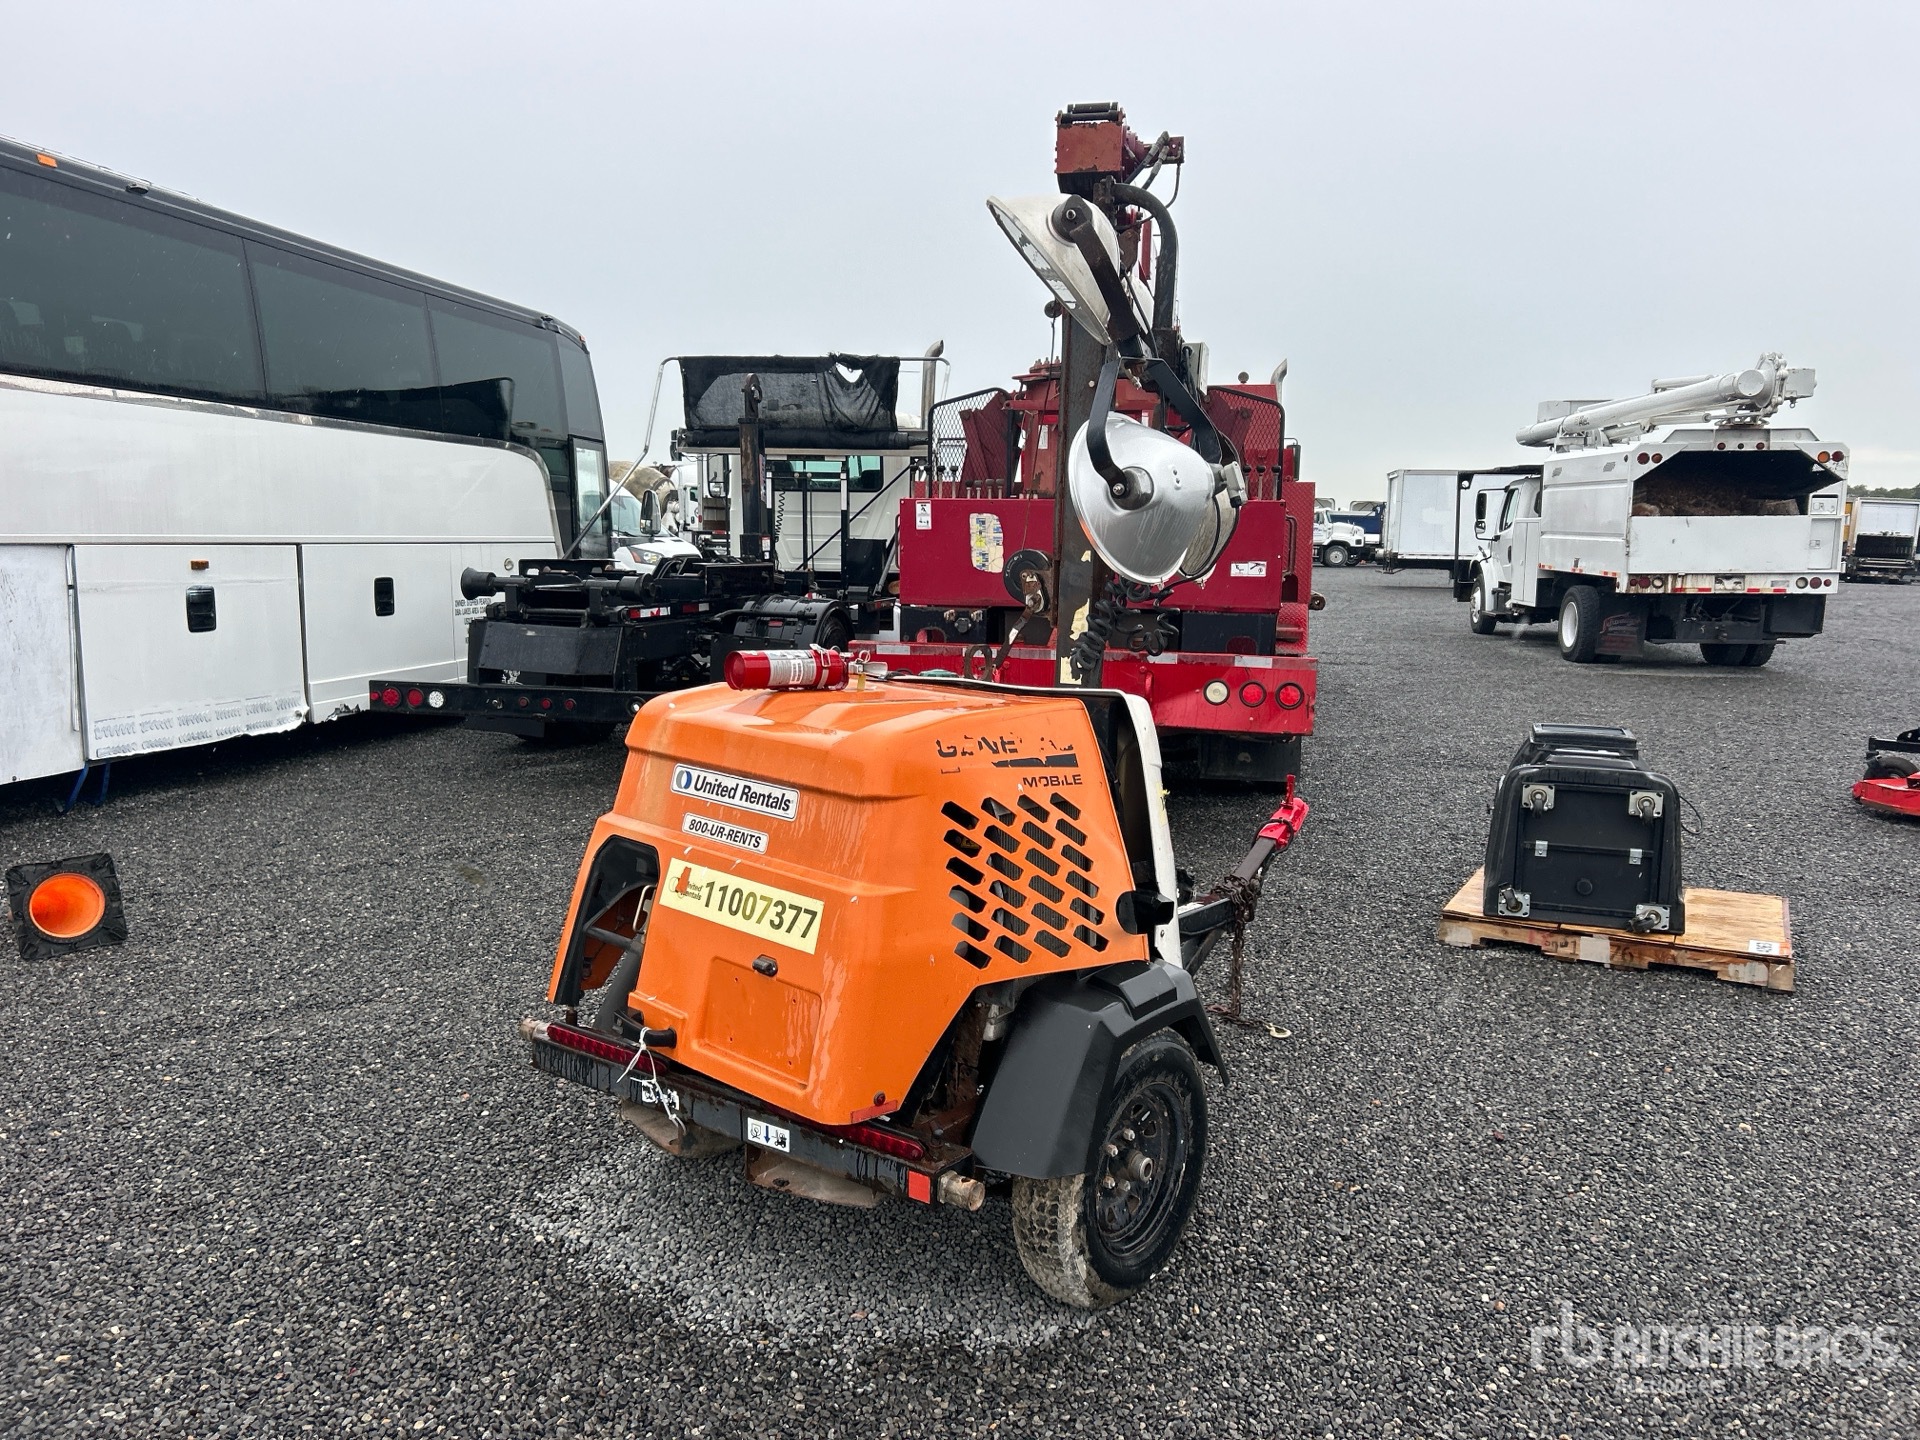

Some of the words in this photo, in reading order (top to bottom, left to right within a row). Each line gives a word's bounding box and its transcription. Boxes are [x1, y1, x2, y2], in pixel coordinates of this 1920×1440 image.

[694, 774, 739, 800] United
[739, 784, 792, 812] Rentals
[688, 819, 762, 849] 800-UR-RENTS
[704, 881, 818, 939] 11007377
